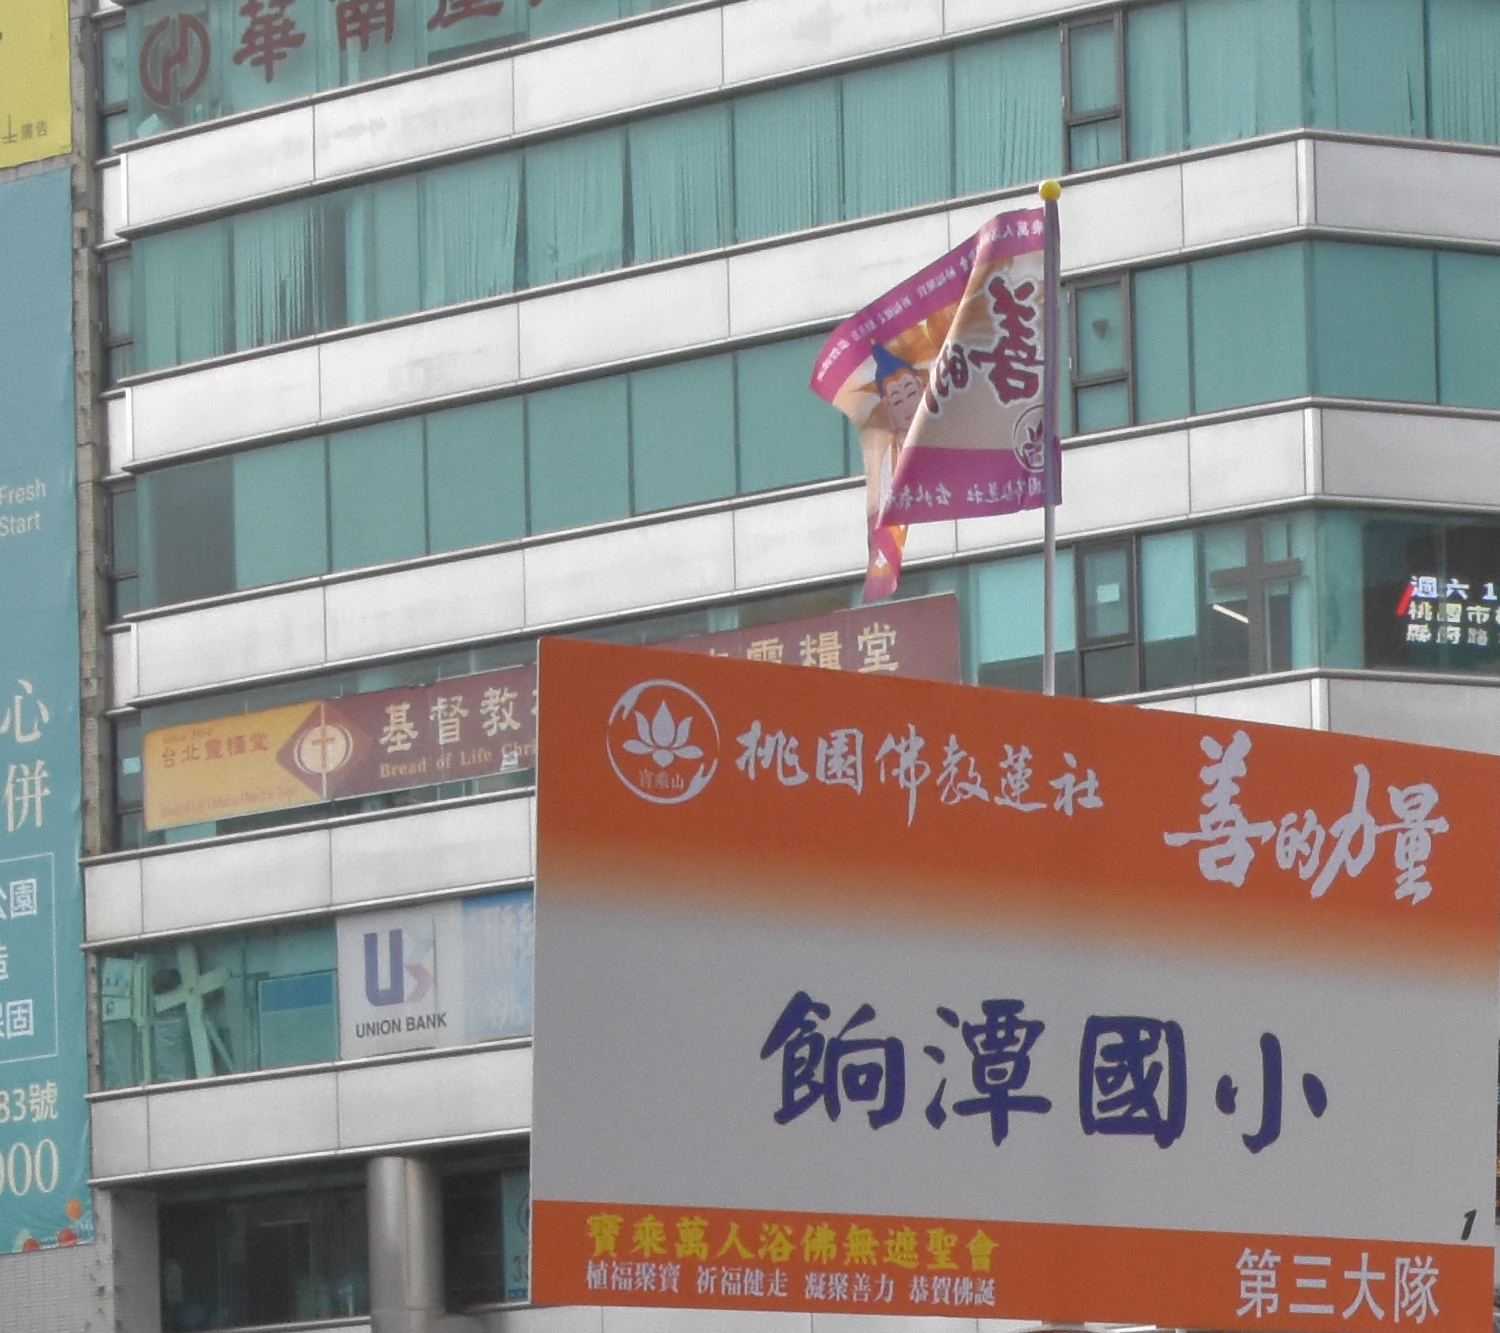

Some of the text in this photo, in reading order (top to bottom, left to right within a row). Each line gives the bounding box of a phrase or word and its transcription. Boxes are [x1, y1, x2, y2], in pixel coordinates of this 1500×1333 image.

[0, 511, 41, 538] Start
[379, 760, 427, 780] Bread
[436, 754, 453, 770] of
[460, 748, 493, 768] Life
[735, 719, 1104, 828] 桃園佛教蓮社
[1163, 730, 1450, 906] 善的力量
[355, 1012, 448, 1039] UNION BANK
[759, 990, 1330, 1155] 餉潭國小
[586, 1213, 999, 1273] 寶乘萬人浴佛無遮聖會
[696, 1265, 790, 1299] 祈福健走
[804, 1272, 896, 1305] 凝聚善力
[908, 1275, 997, 1308] 恭賀佛誕
[1233, 1245, 1442, 1325] 第三大隊
